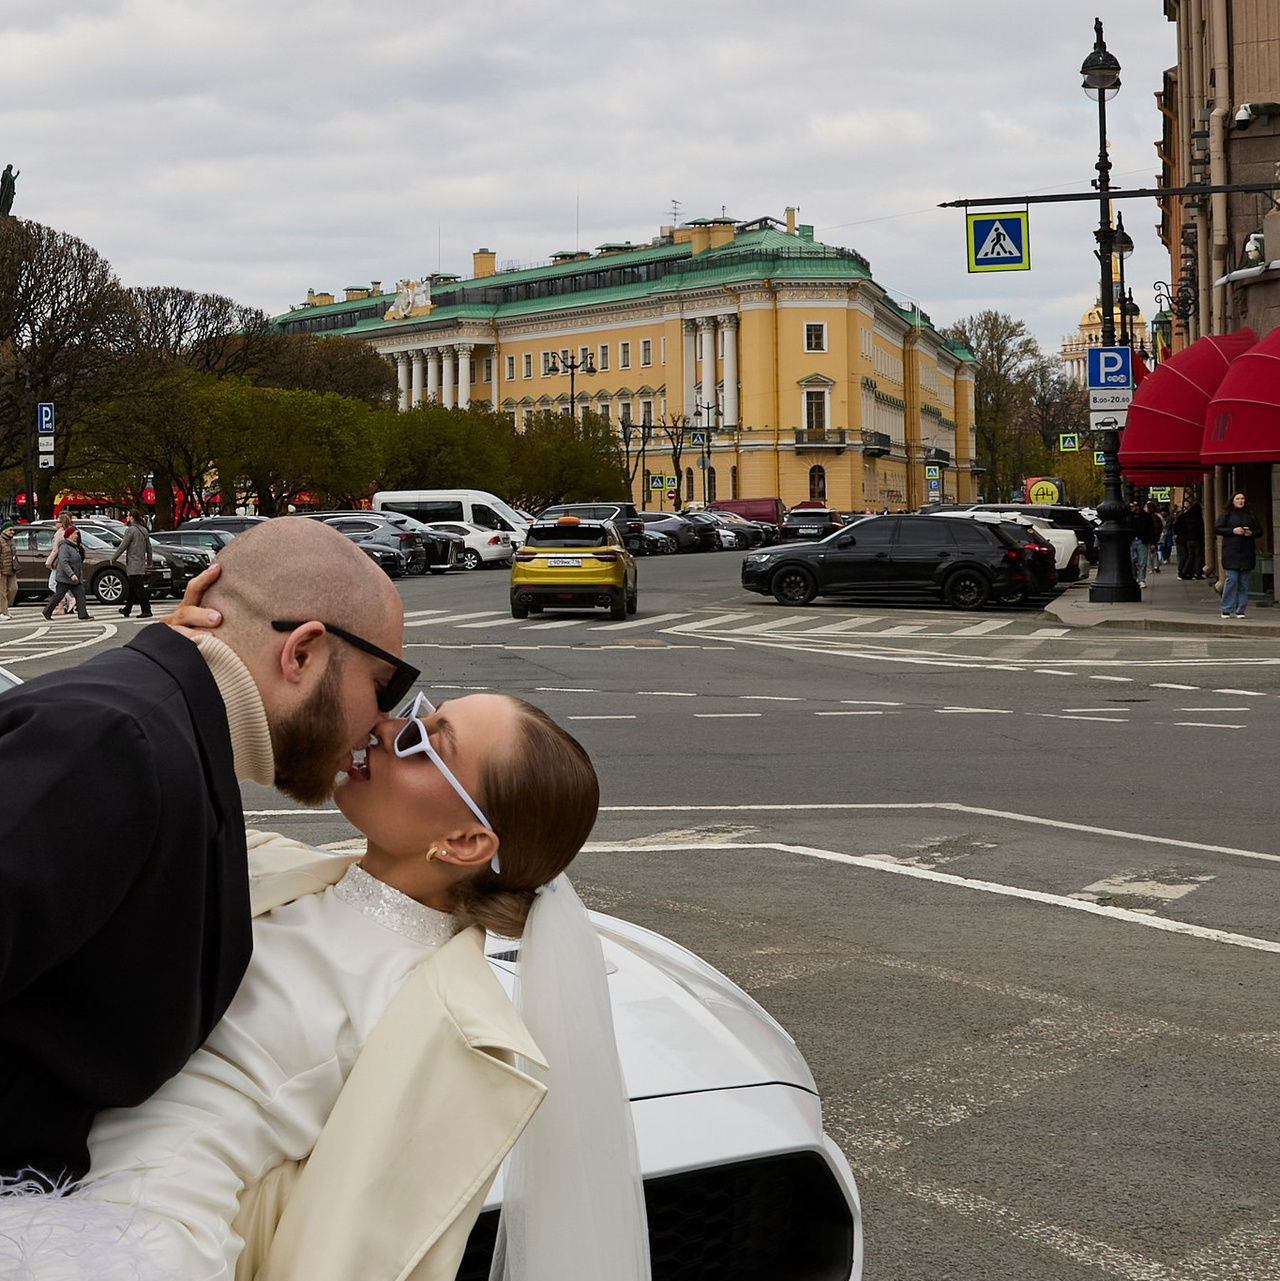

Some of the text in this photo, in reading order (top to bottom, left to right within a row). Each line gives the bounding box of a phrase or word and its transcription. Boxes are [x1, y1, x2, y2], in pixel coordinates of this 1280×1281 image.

[1099, 351, 1123, 384] P
[1092, 396, 1130, 404] 8.00-20.00
[42, 406, 51, 429] P
